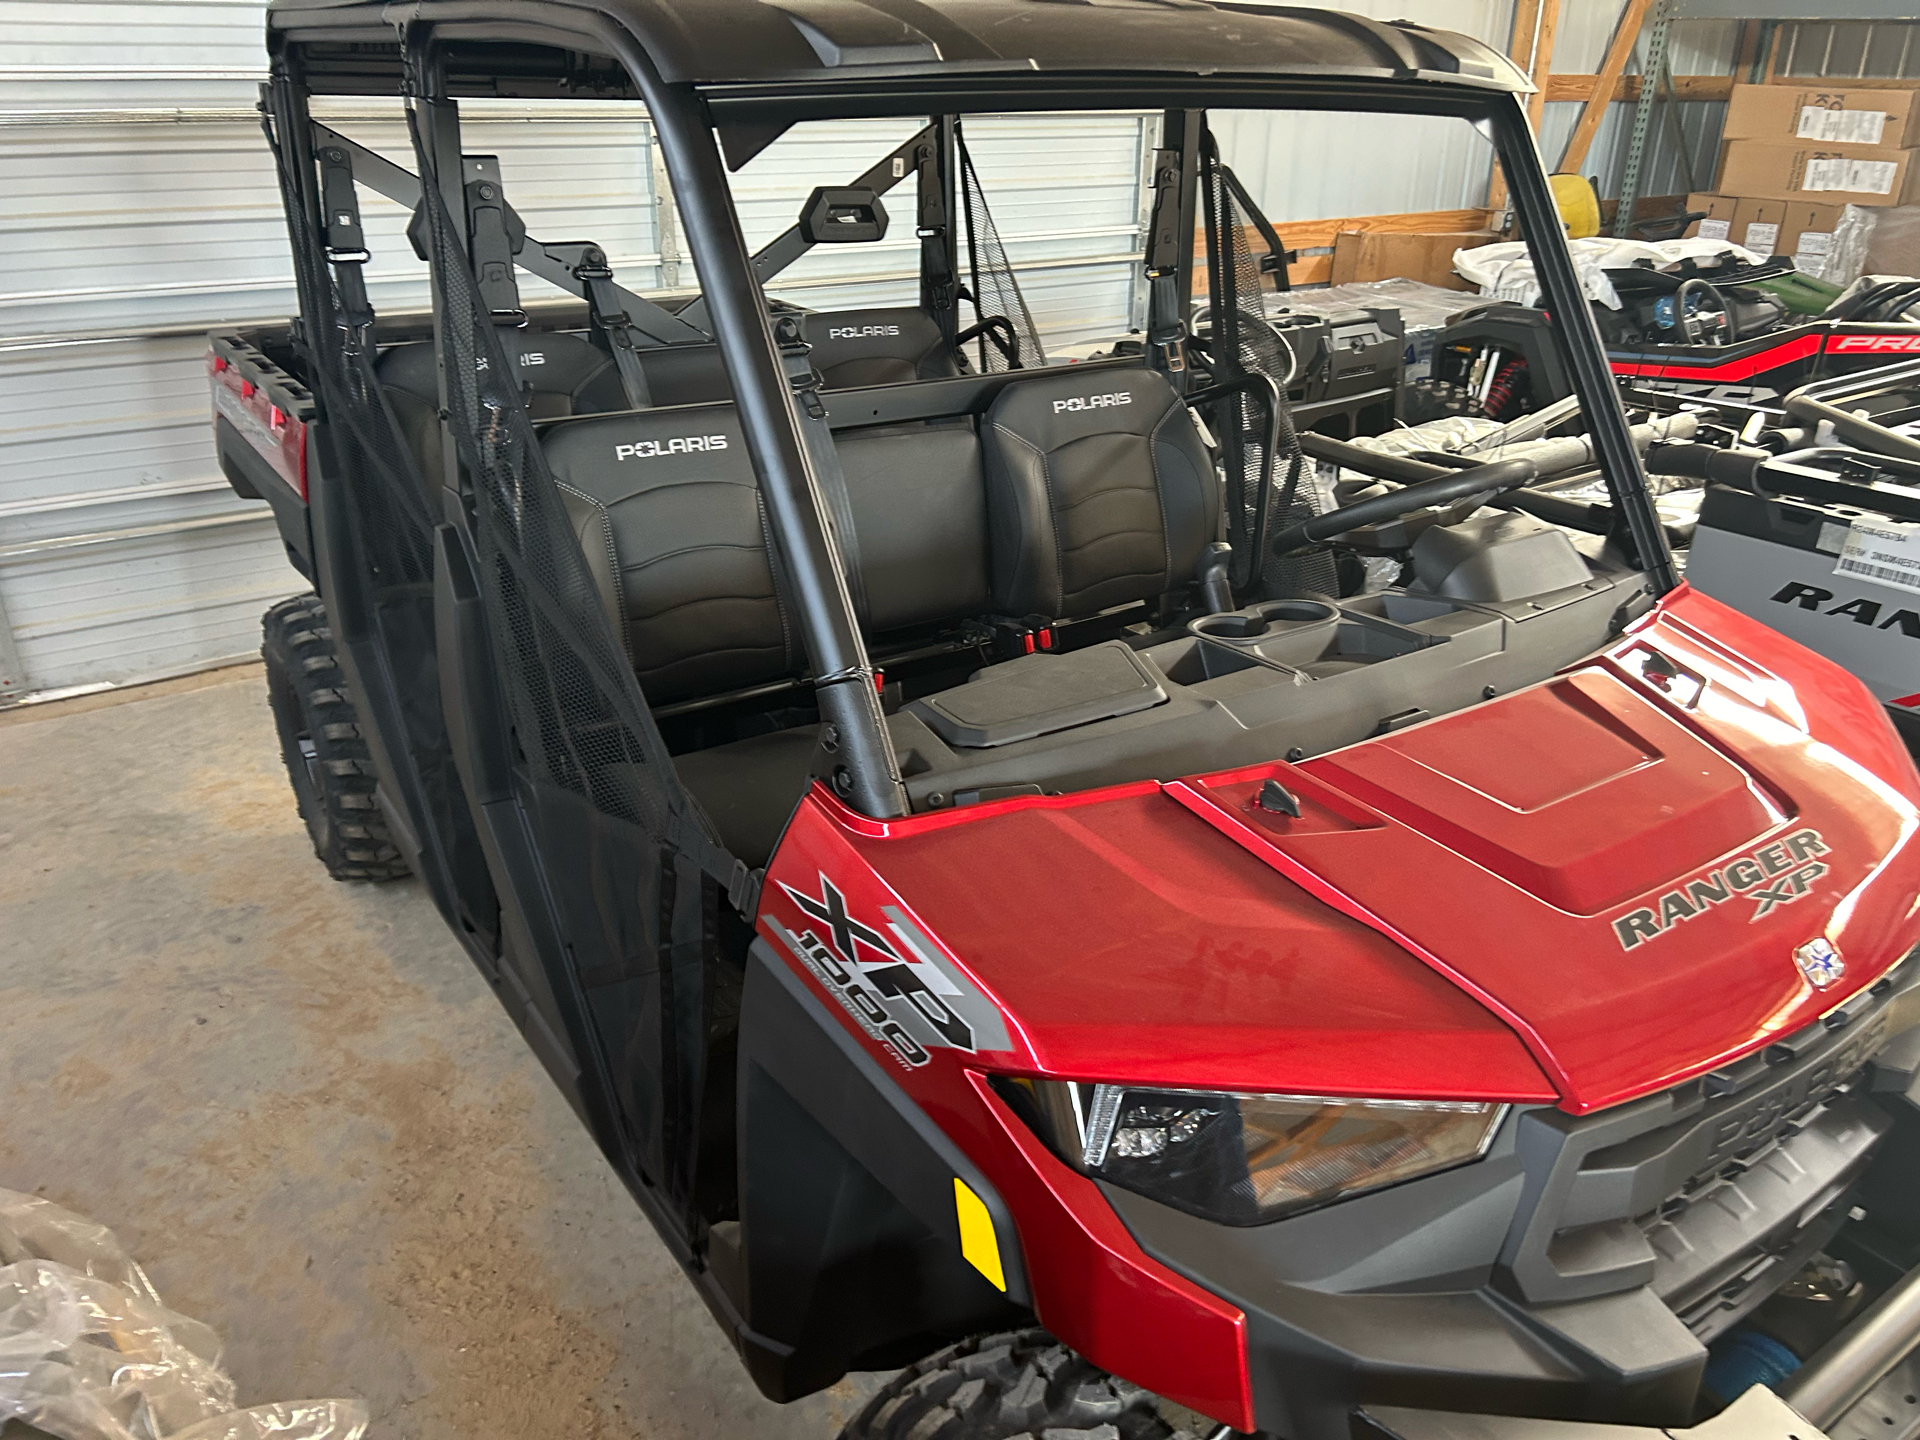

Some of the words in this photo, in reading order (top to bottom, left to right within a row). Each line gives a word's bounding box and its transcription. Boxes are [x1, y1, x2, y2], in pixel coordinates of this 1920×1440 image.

[829, 323, 900, 341] POLARIS
[615, 434, 728, 461] POLARIS
[1052, 391, 1132, 414] POLARIS
[1611, 828, 1832, 951] RANGER
[1744, 860, 1830, 924] XP
[774, 869, 977, 1054] XP
[798, 929, 932, 1067] 1000
[793, 947, 823, 978] DUAL
[821, 976, 886, 1041] OVERHEAD
[882, 1043, 913, 1072] CAM
